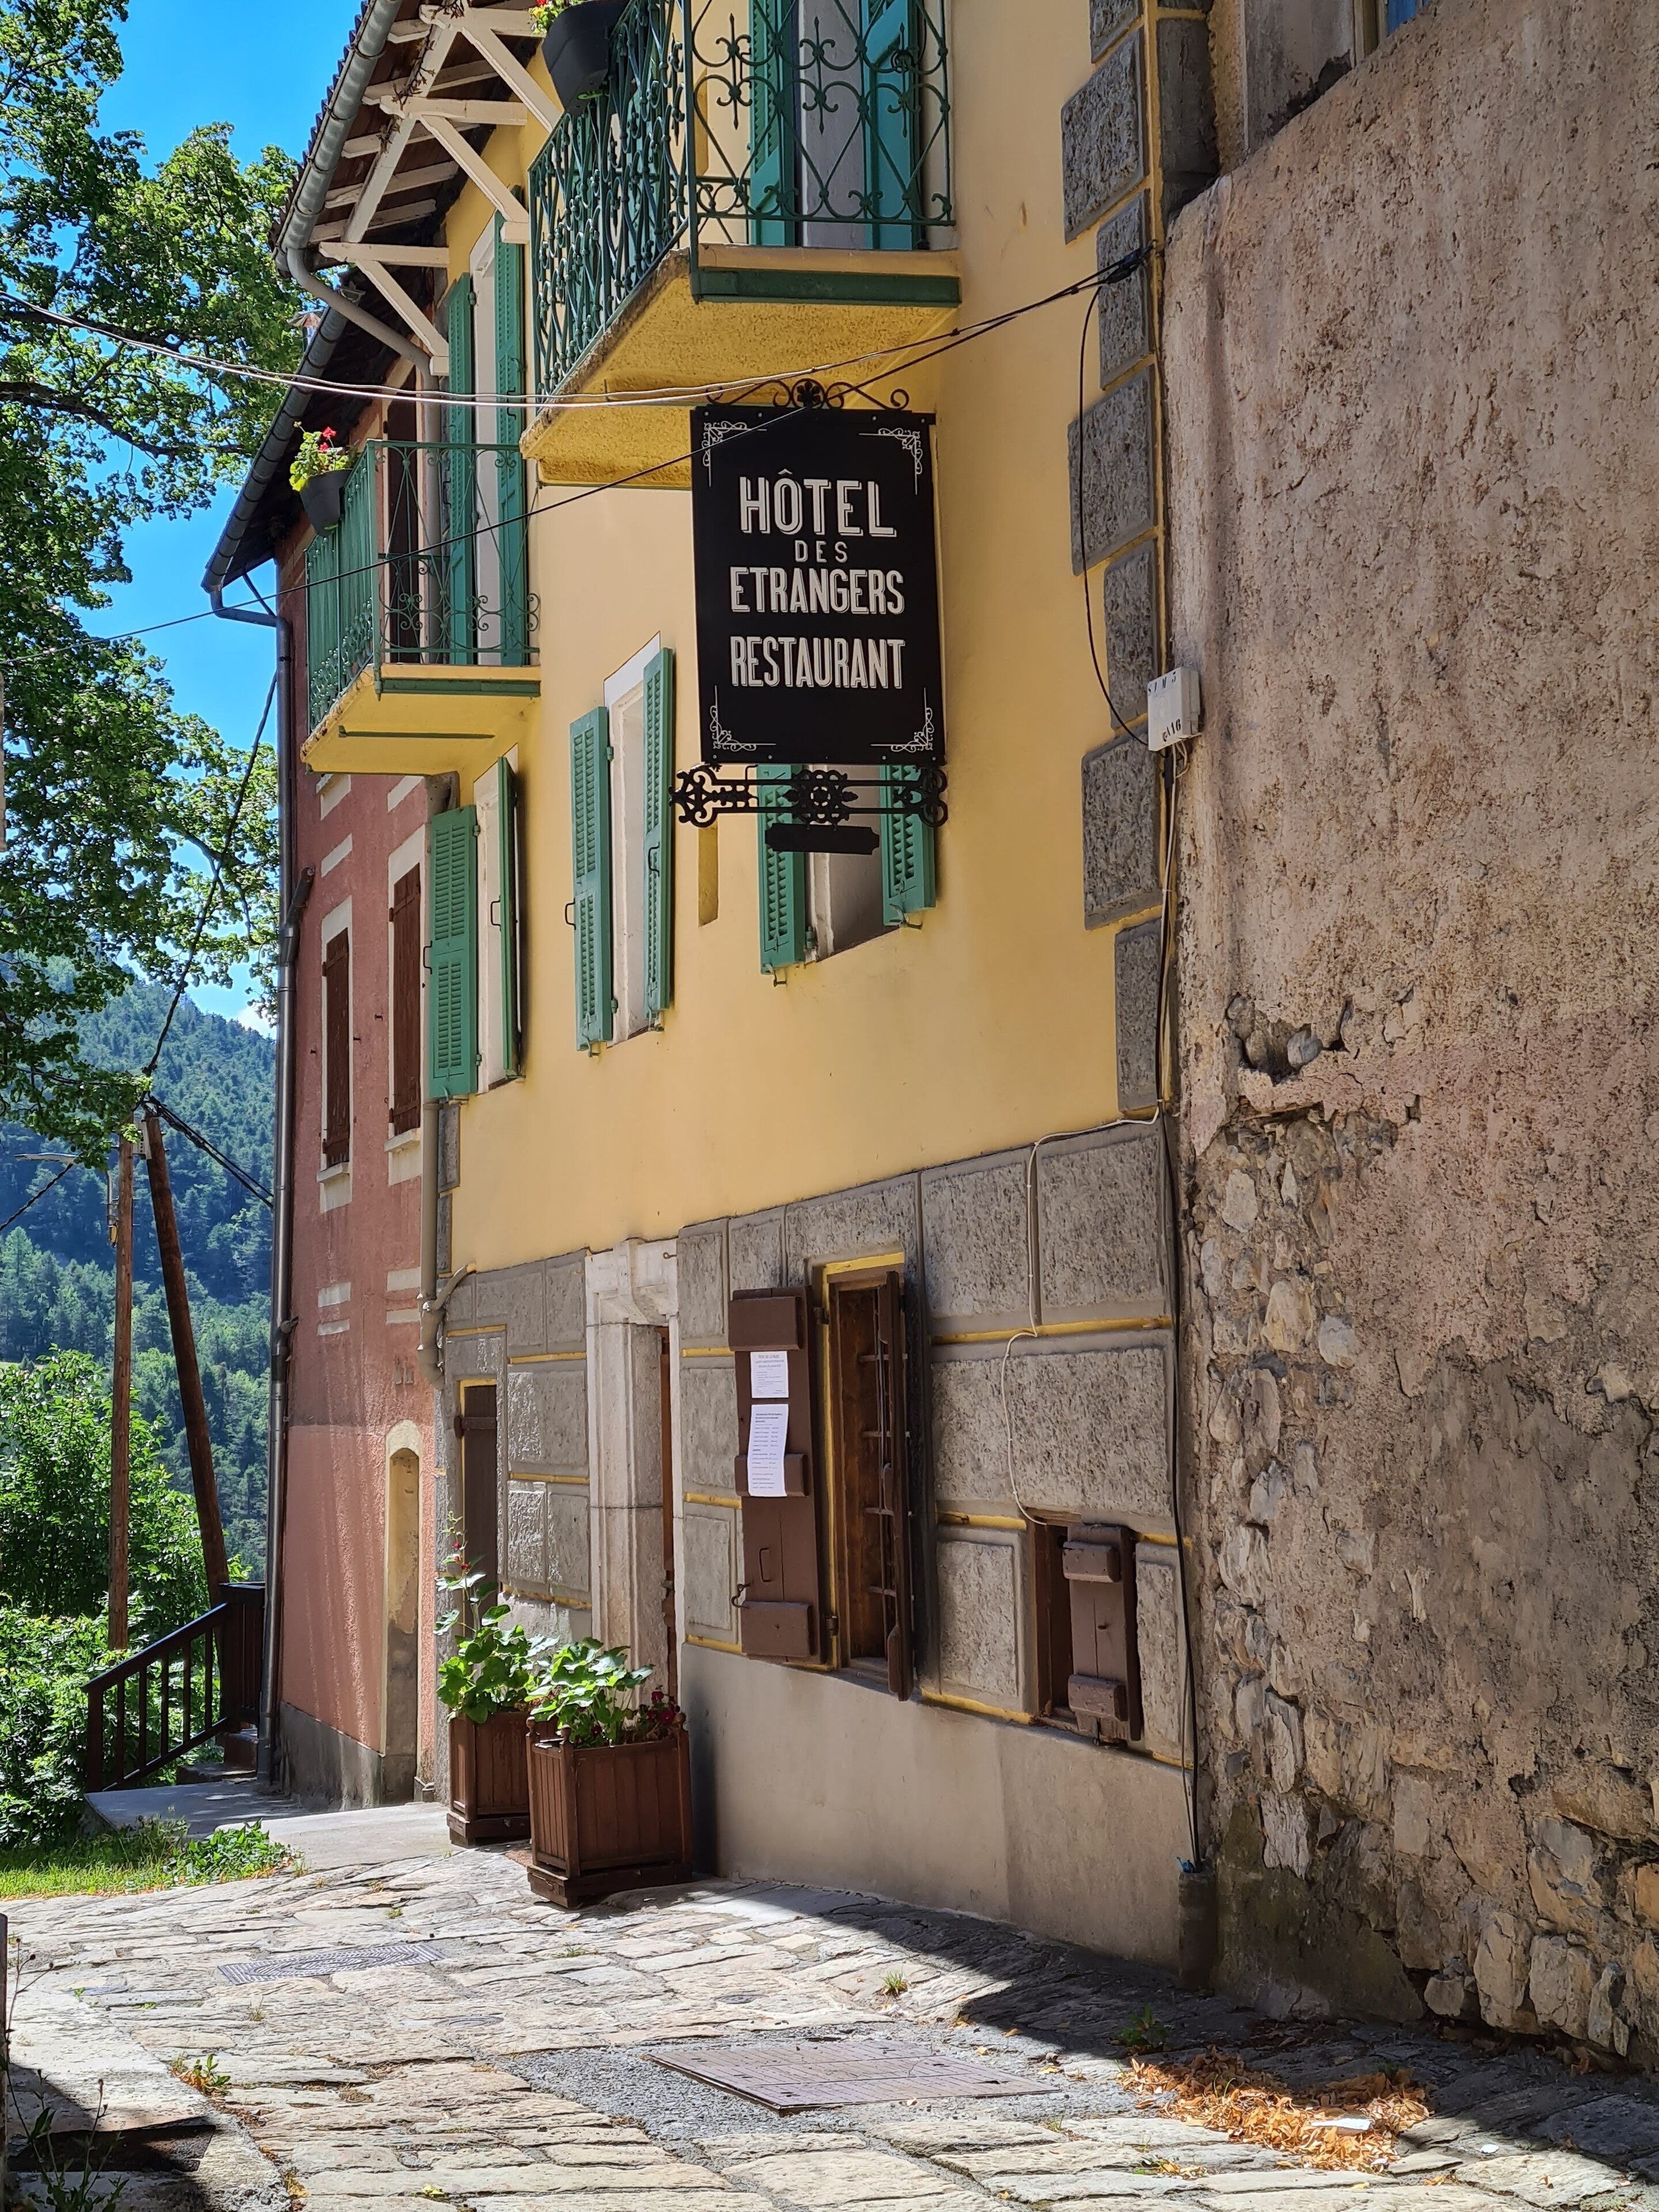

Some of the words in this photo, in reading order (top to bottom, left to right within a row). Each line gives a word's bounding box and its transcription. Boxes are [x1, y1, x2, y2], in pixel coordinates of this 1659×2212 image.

[740, 468, 897, 537] HÔTEL
[795, 540, 847, 563] DES
[730, 566, 905, 615] ETRANGERS
[730, 636, 906, 689] RESTAURANT
